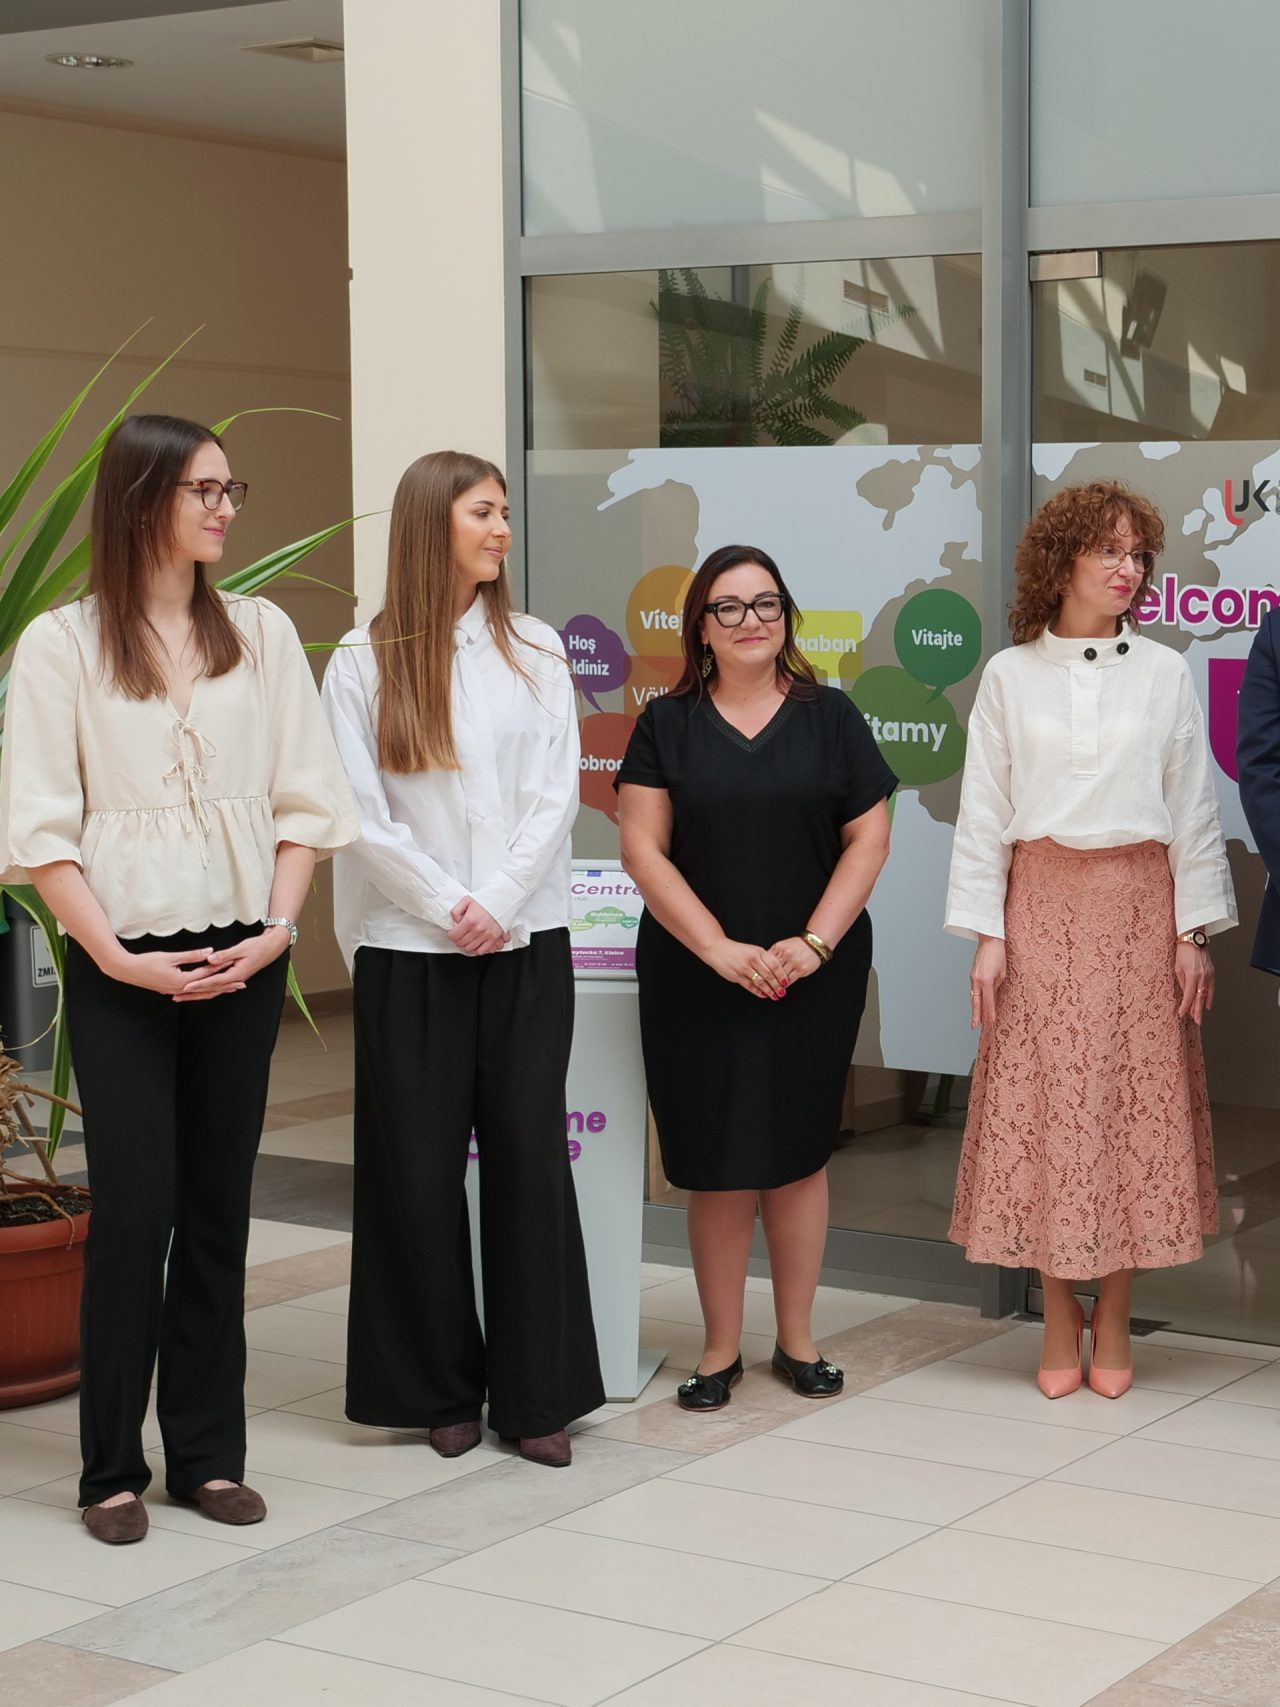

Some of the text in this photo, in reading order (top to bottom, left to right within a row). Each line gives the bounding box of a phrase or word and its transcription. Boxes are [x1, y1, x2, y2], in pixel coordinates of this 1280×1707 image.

[569, 635, 596, 654] Hoş
[912, 628, 963, 650] Vitajte
[571, 659, 610, 676] ldiniz
[571, 883, 641, 896] Centre
